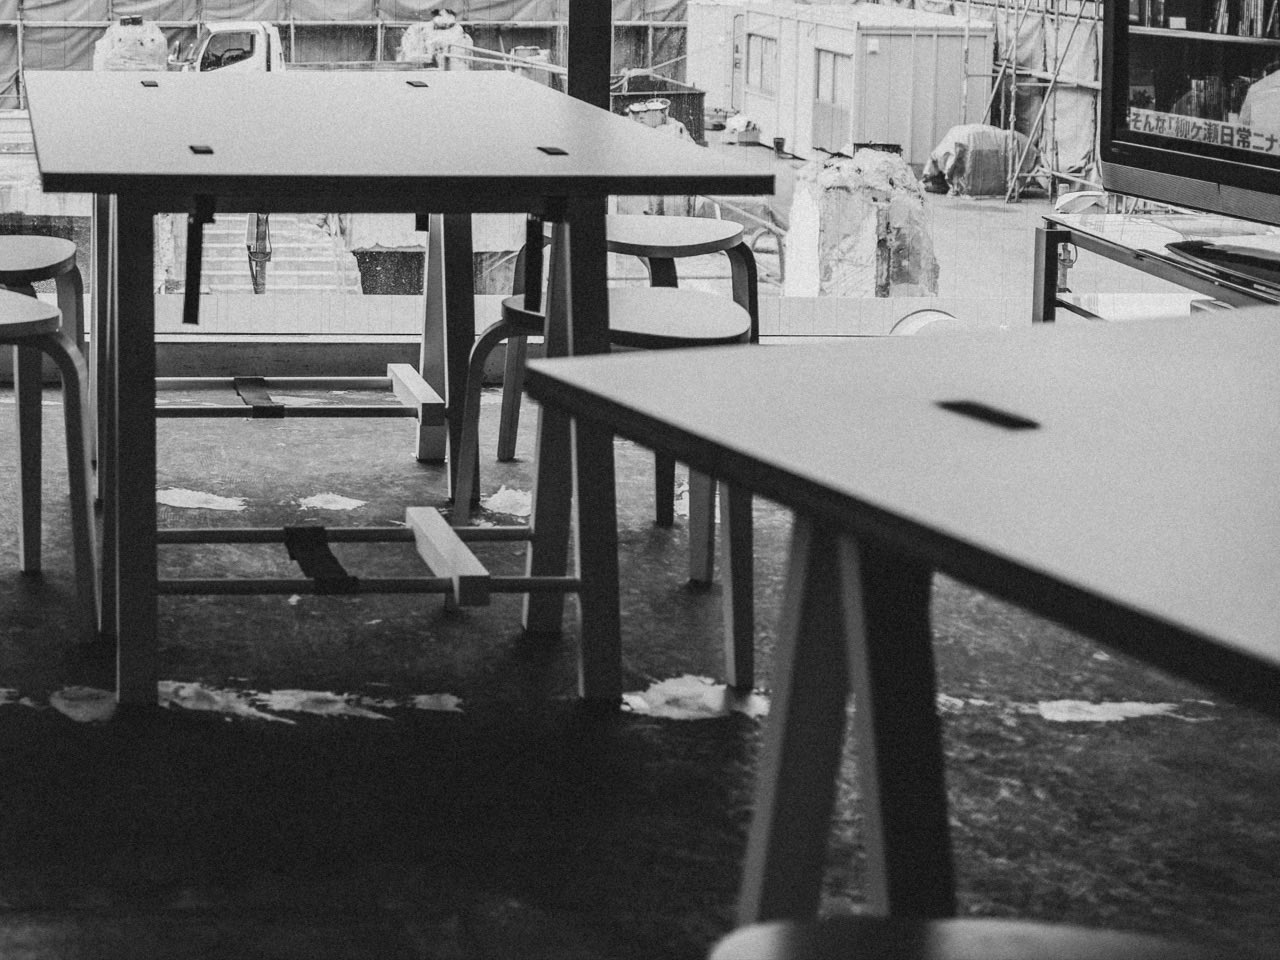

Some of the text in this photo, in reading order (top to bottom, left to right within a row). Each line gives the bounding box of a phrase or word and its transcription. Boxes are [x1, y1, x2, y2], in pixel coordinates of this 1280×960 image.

[1131, 111, 1280, 152] そんな「柳ケ瀬日常ニナ
